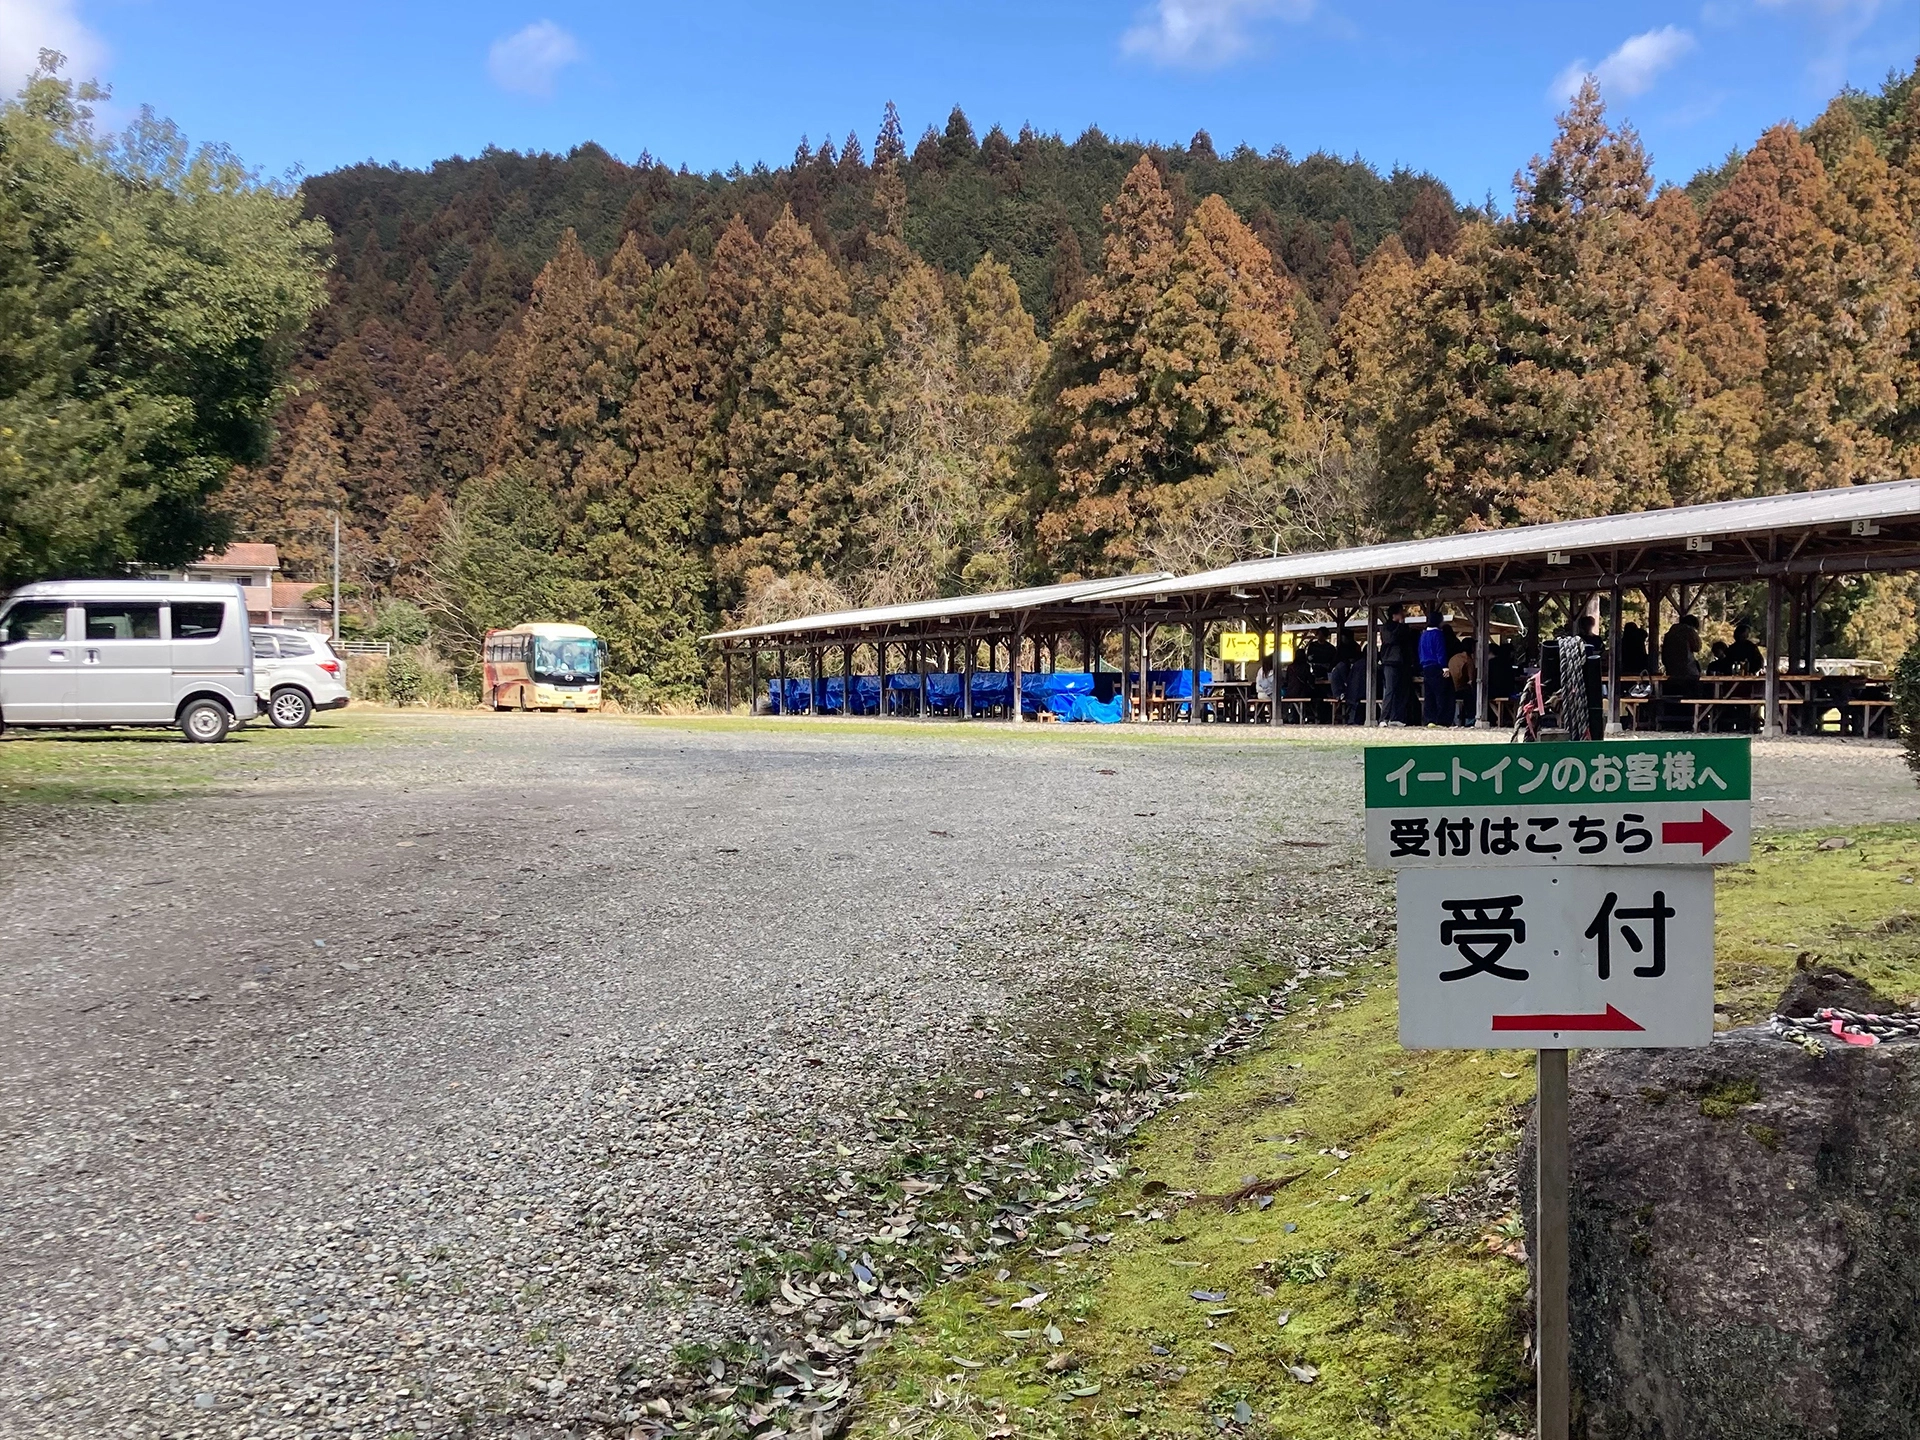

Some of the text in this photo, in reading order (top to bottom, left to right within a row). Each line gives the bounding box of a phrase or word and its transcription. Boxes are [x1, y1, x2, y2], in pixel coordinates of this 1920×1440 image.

[1857, 521, 1865, 533] 3
[1691, 538, 1698, 549] 5
[1551, 553, 1557, 563] 7
[1423, 566, 1429, 575] 9
[1385, 751, 1728, 796] イートインのお客様へ
[1389, 813, 1653, 858] 受付はこちら
[1438, 890, 1676, 982] 受付
